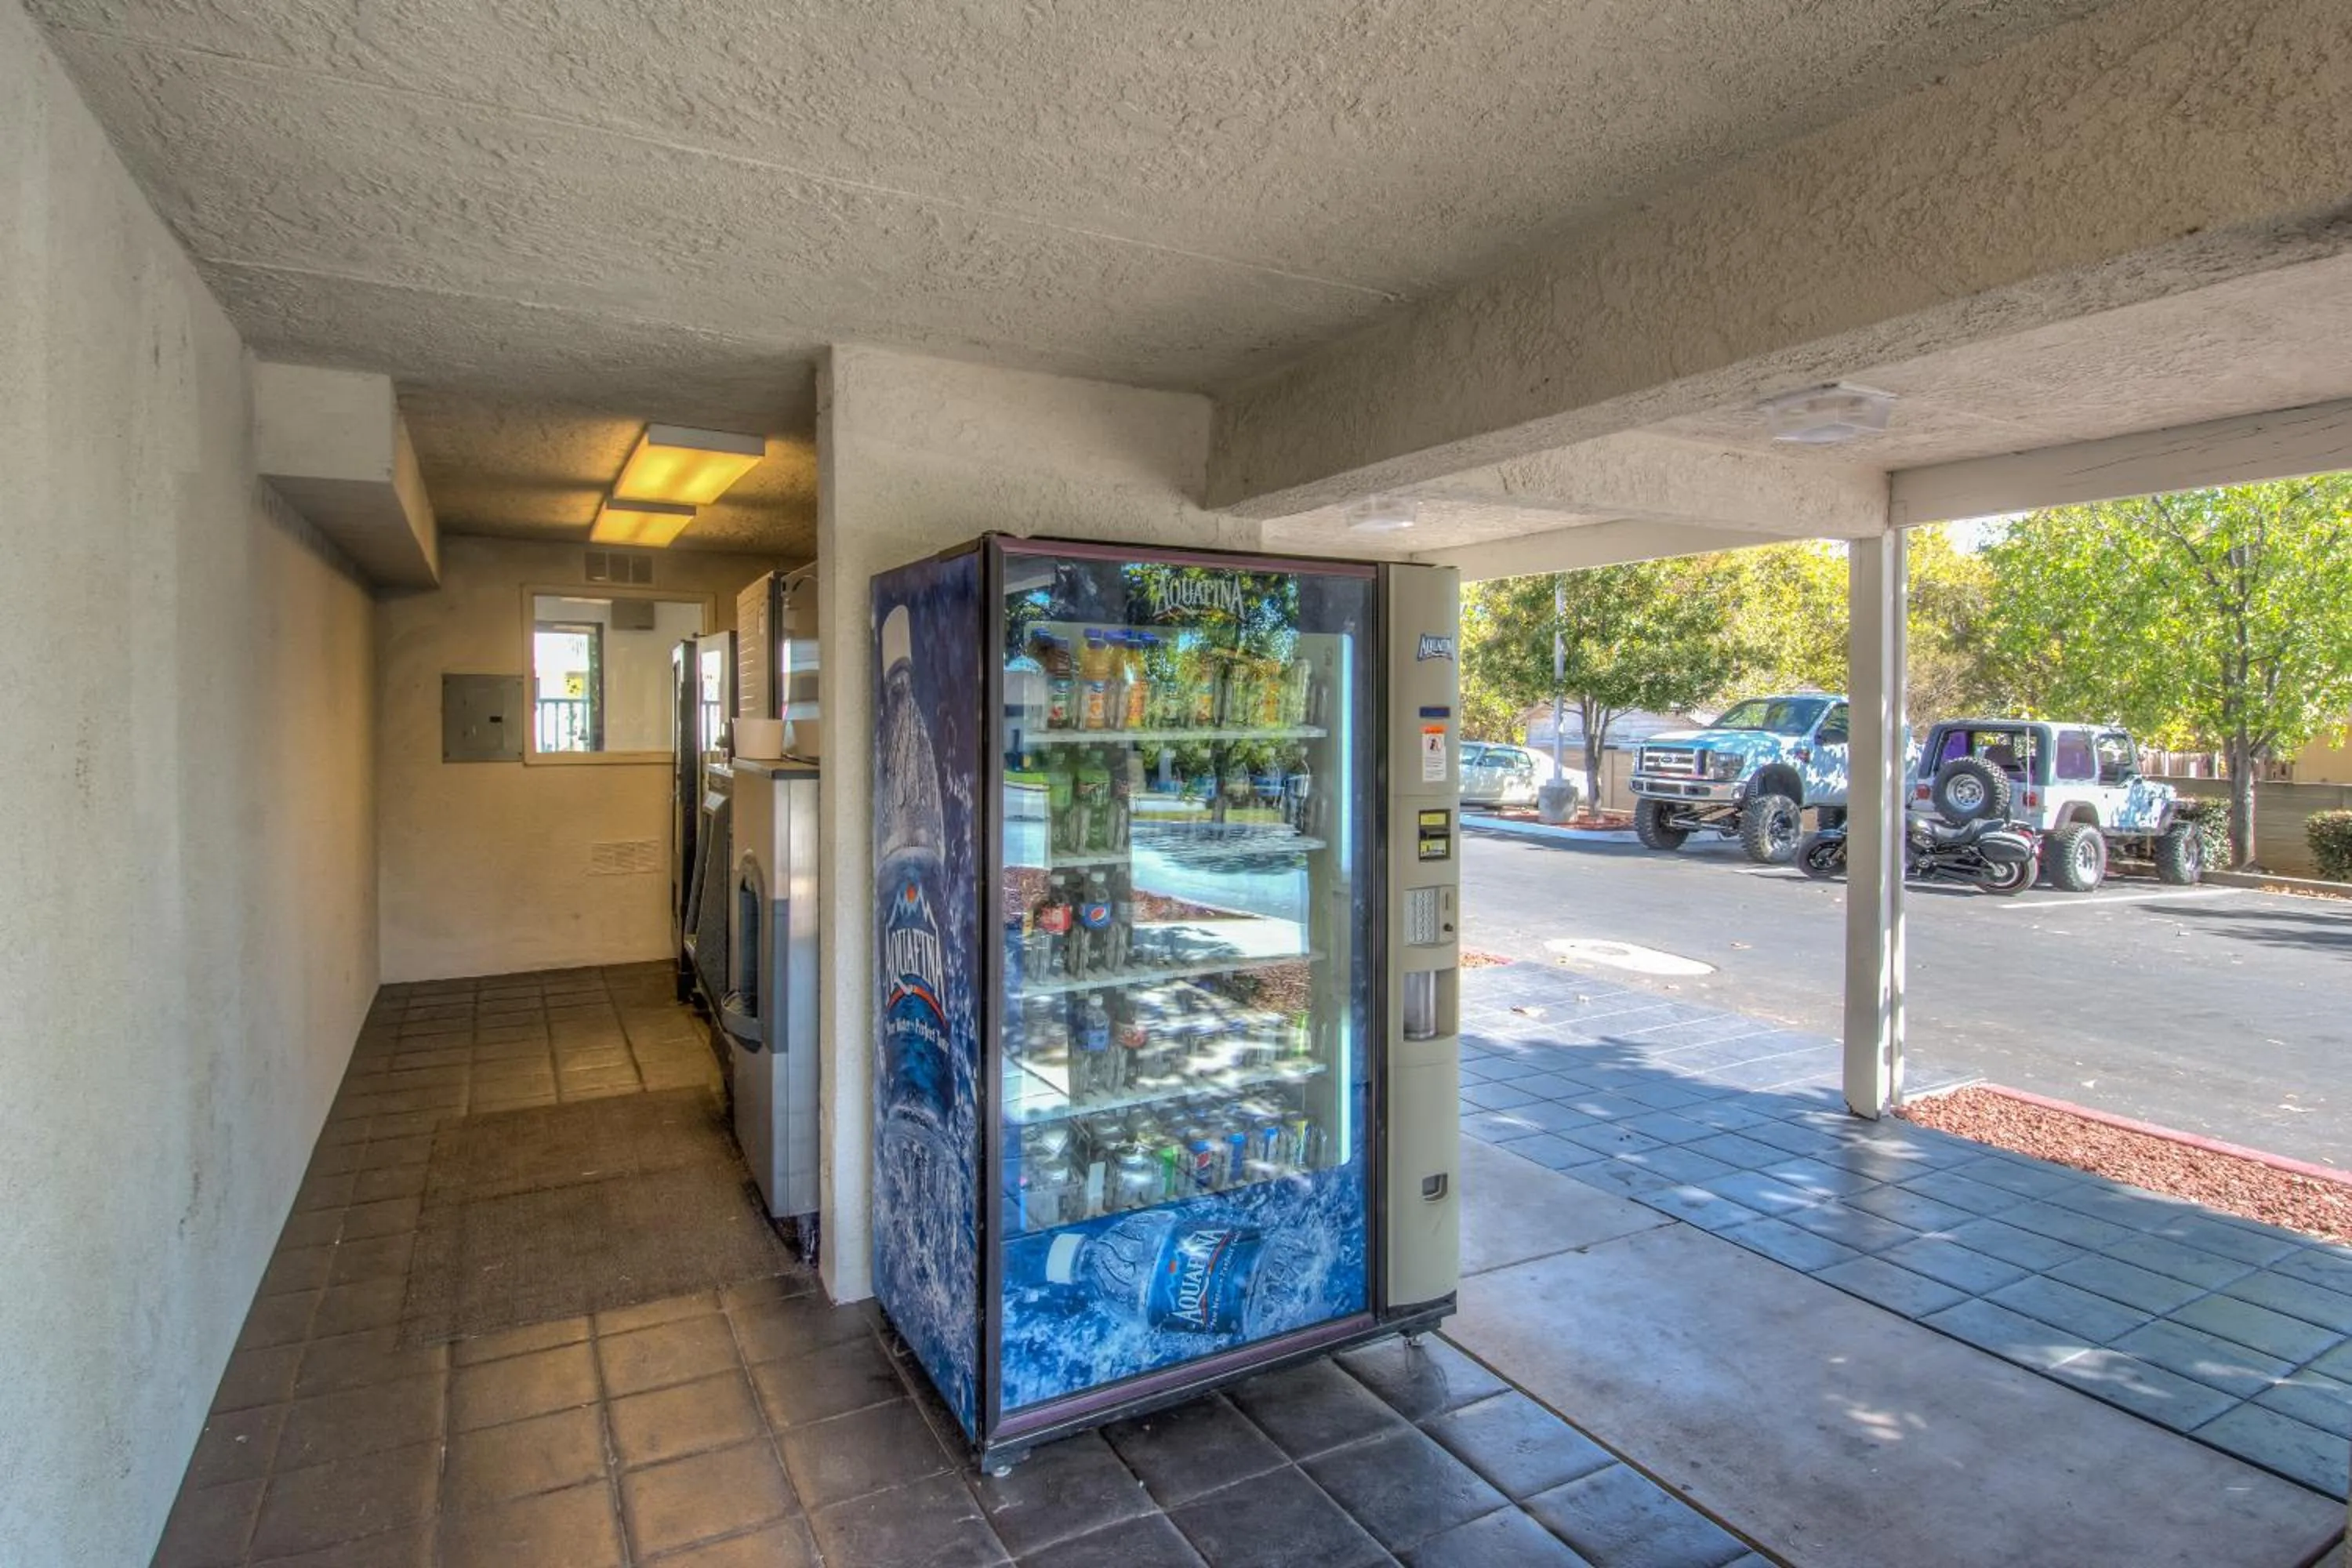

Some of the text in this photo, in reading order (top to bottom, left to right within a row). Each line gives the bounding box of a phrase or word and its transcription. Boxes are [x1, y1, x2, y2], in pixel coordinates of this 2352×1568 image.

[1154, 572, 1247, 620] AQUAFINA
[885, 924, 947, 1018] AQUAFINA
[1171, 1229, 1230, 1326] AQUAFINA
